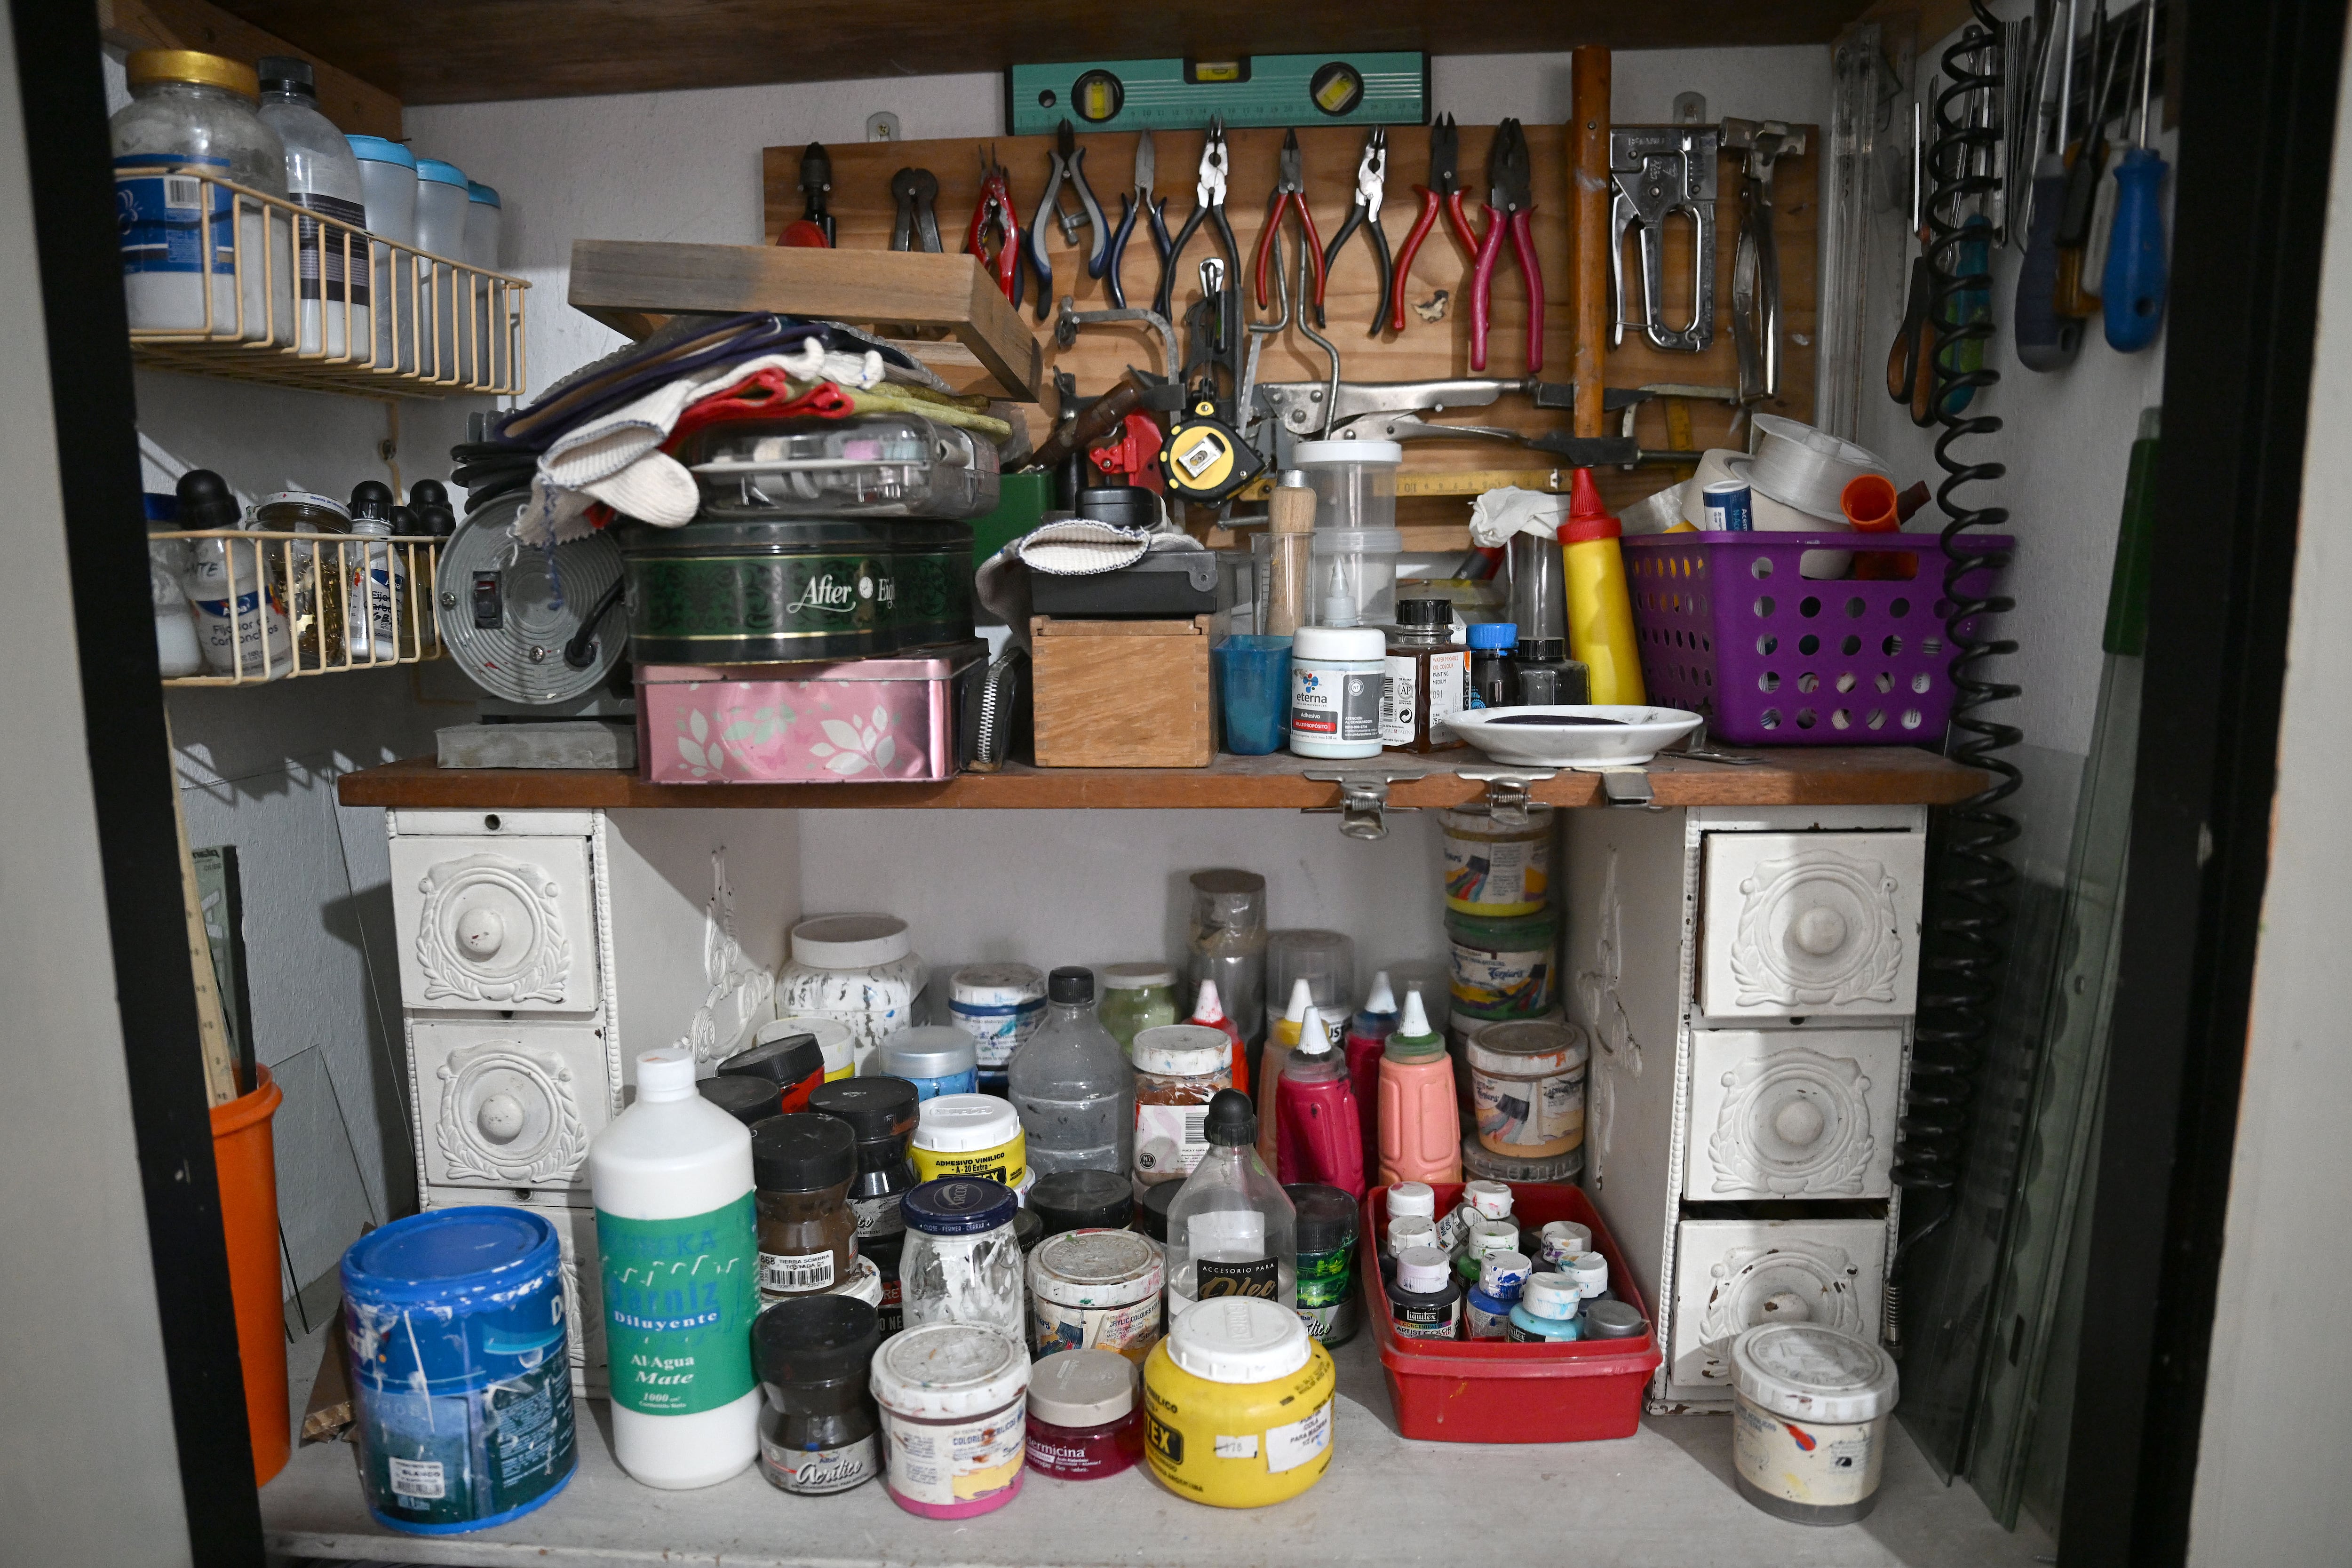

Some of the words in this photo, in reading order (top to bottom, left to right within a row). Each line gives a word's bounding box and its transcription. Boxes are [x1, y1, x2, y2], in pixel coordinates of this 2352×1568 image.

[787, 574, 856, 613] After
[1401, 687, 1411, 695] AP
[1297, 692, 1327, 703] eterna
[975, 1153, 1005, 1163] VINILICO
[973, 1163, 988, 1172] Extra
[761, 1255, 776, 1265] 868
[804, 1254, 830, 1264] SOMBRA
[1203, 1266, 1251, 1274] ACCESORIO
[1256, 1263, 1274, 1272] PARA
[1130, 1309, 1151, 1322] COLOURS
[1406, 1309, 1437, 1322] Liquitex
[614, 1311, 718, 1332] Diluyente
[1397, 1326, 1421, 1336] ARTIST
[1424, 1326, 1452, 1335] COLOR
[631, 1354, 647, 1366] Al
[651, 1357, 694, 1371] Agua
[635, 1371, 694, 1385] Mate
[644, 1392, 669, 1402] 1000
